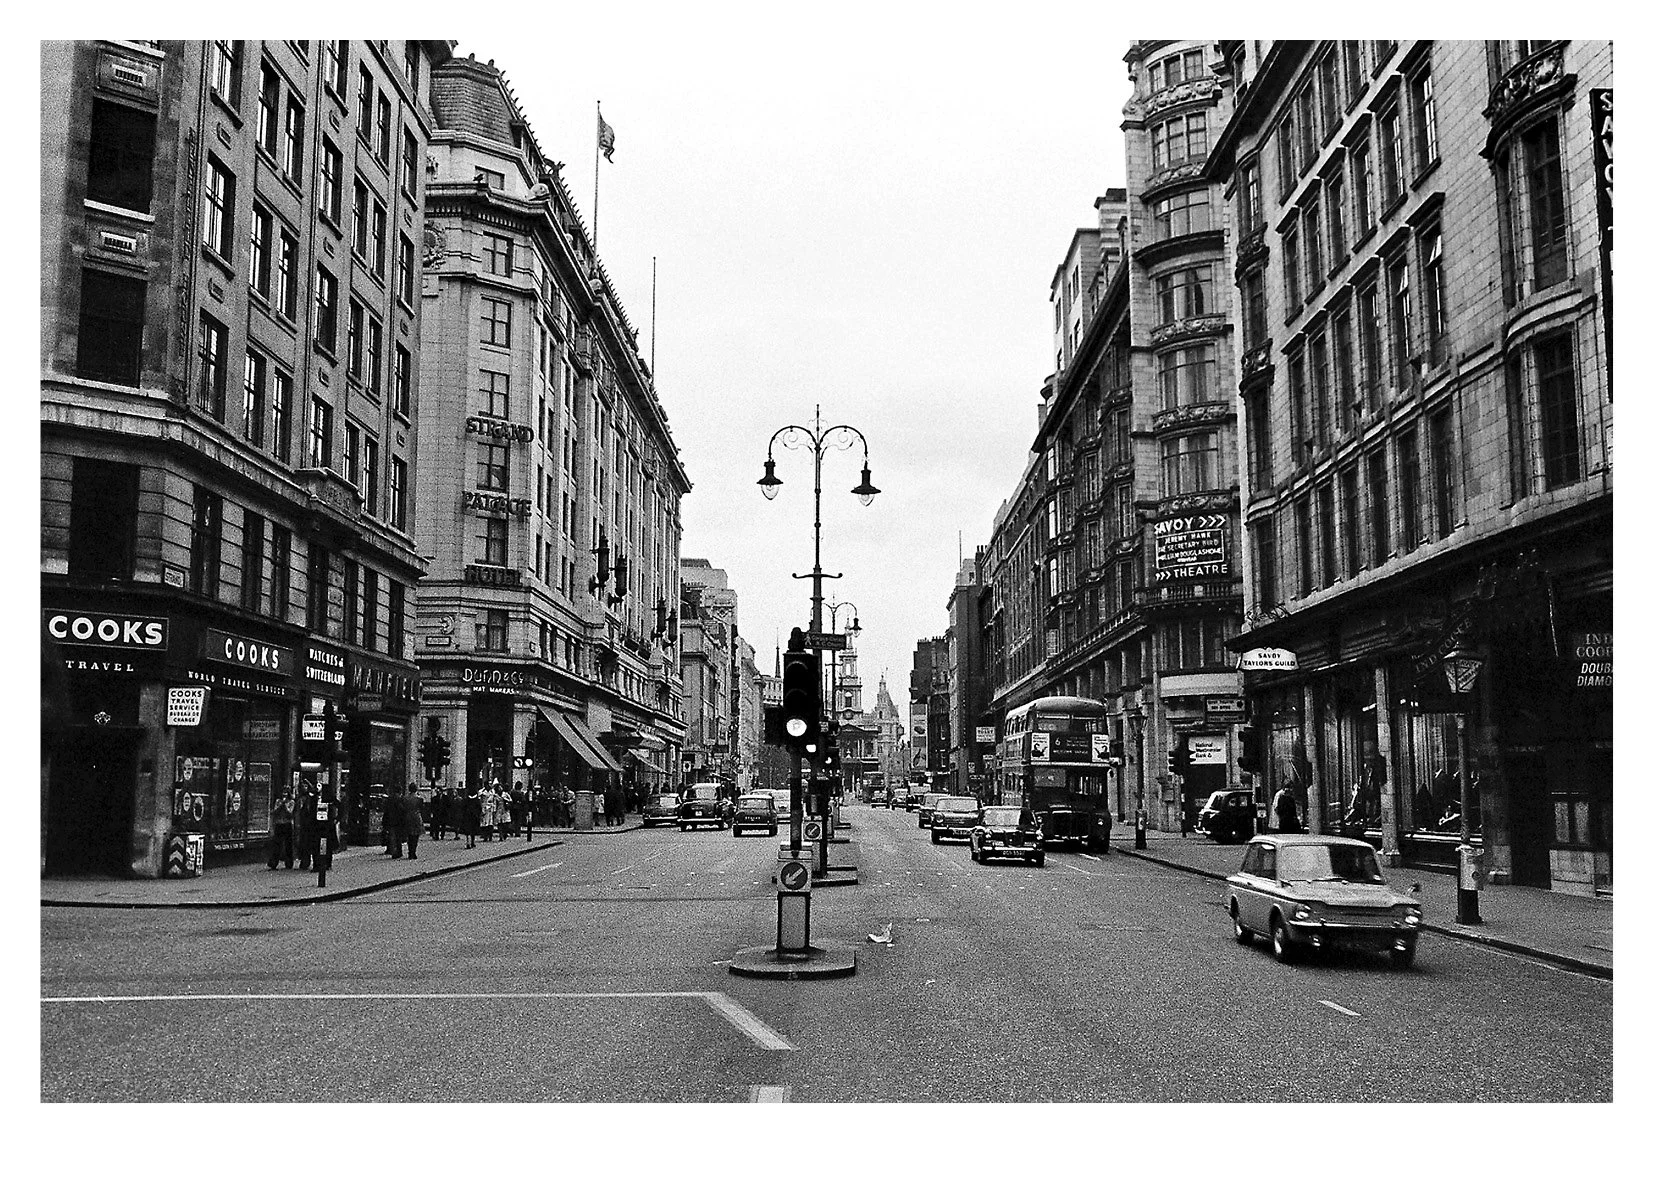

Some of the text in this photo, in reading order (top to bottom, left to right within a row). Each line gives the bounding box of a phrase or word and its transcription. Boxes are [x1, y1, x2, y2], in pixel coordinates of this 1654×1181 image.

[465, 417, 534, 443] STRAND
[462, 491, 532, 517] PALACE
[1154, 517, 1193, 535] SAVOY
[1174, 564, 1228, 578] THEATRE
[48, 615, 163, 645] COOKS
[225, 638, 279, 669] COOKS
[65, 660, 134, 672] TRAVEL
[188, 670, 216, 683] WORLD
[306, 666, 346, 686] SWITZERLAND
[170, 690, 202, 698] COOKS
